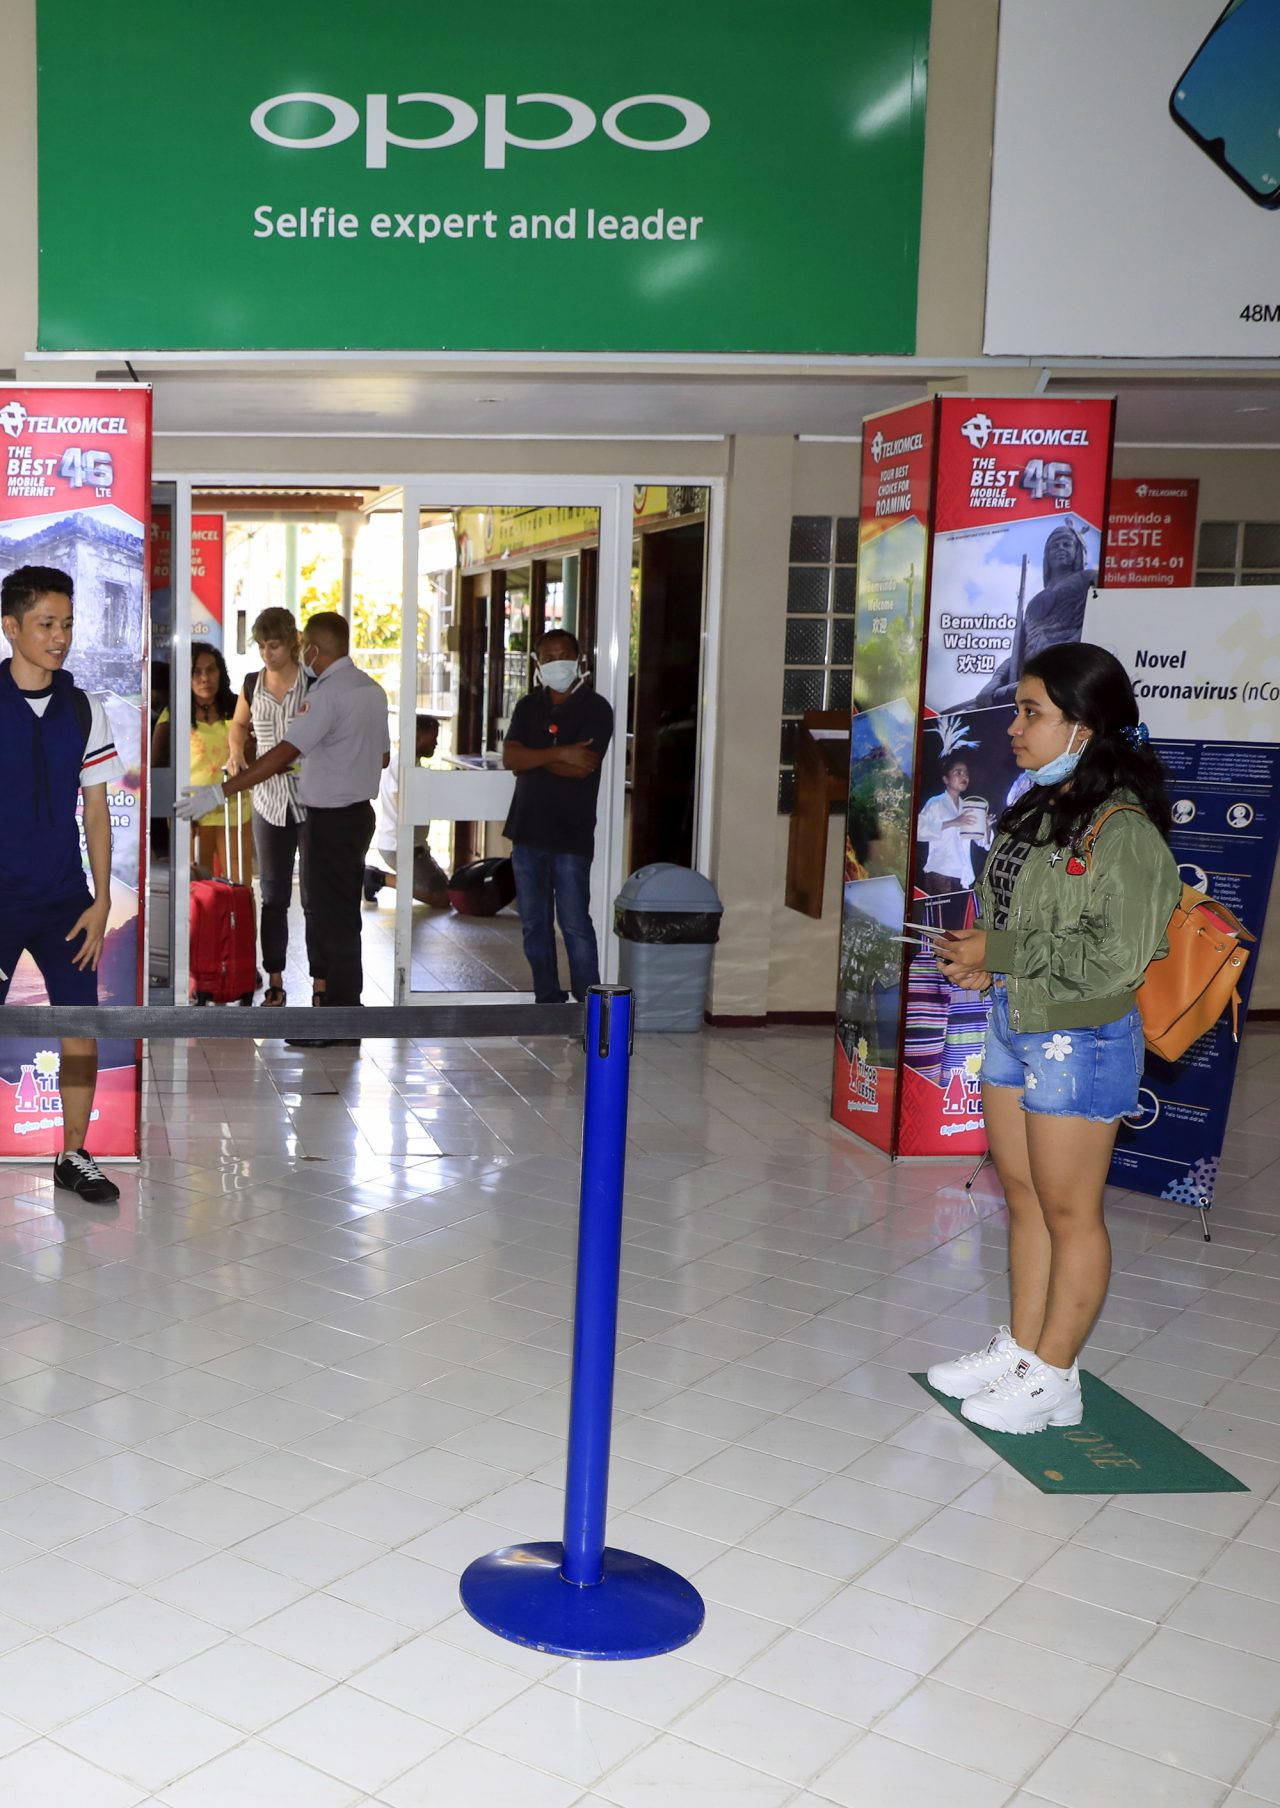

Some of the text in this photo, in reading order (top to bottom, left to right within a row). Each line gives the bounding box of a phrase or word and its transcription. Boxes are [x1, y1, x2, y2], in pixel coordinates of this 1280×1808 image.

[249, 91, 712, 170] oppo
[253, 205, 704, 244] Selfie expert and leader
[27, 416, 128, 434] TELKOMCEL
[991, 428, 1089, 446] TELKOMCEL
[7, 446, 33, 458] THE
[882, 433, 923, 458] TELKOMCEL
[7, 459, 57, 476] BEST
[58, 447, 114, 488] 4G
[972, 457, 996, 469] THE
[7, 476, 46, 487] MOBILE
[880, 465, 910, 482] YOUR BEST
[970, 470, 1020, 487] BEST
[1020, 458, 1073, 499] 4G
[7, 486, 56, 497] INTERNET
[95, 487, 112, 498] LTE
[878, 480, 910, 496] CHOICE FOR
[970, 488, 1008, 498] MOBILE
[1147, 488, 1188, 498] TELKOMCEL
[875, 494, 912, 517] ROAMING
[969, 498, 1017, 508] INTERNET
[1055, 499, 1071, 509] LTE
[1108, 512, 1172, 524] emvindo a
[1120, 558, 1135, 568] or
[1136, 557, 1161, 568] 514
[1169, 557, 1184, 568] 01
[1129, 573, 1174, 585] Roaming
[868, 599, 894, 611] Welcome
[941, 614, 1017, 629] Bemvindo
[944, 634, 1011, 649] Welcome
[957, 654, 995, 674] 欢迎
[1135, 650, 1186, 669] Novel
[1131, 679, 1238, 700] Coronavirus
[858, 1062, 877, 1084] TIMOR
[858, 1082, 876, 1102] LESTE
[1030, 1387, 1044, 1398] FILA
